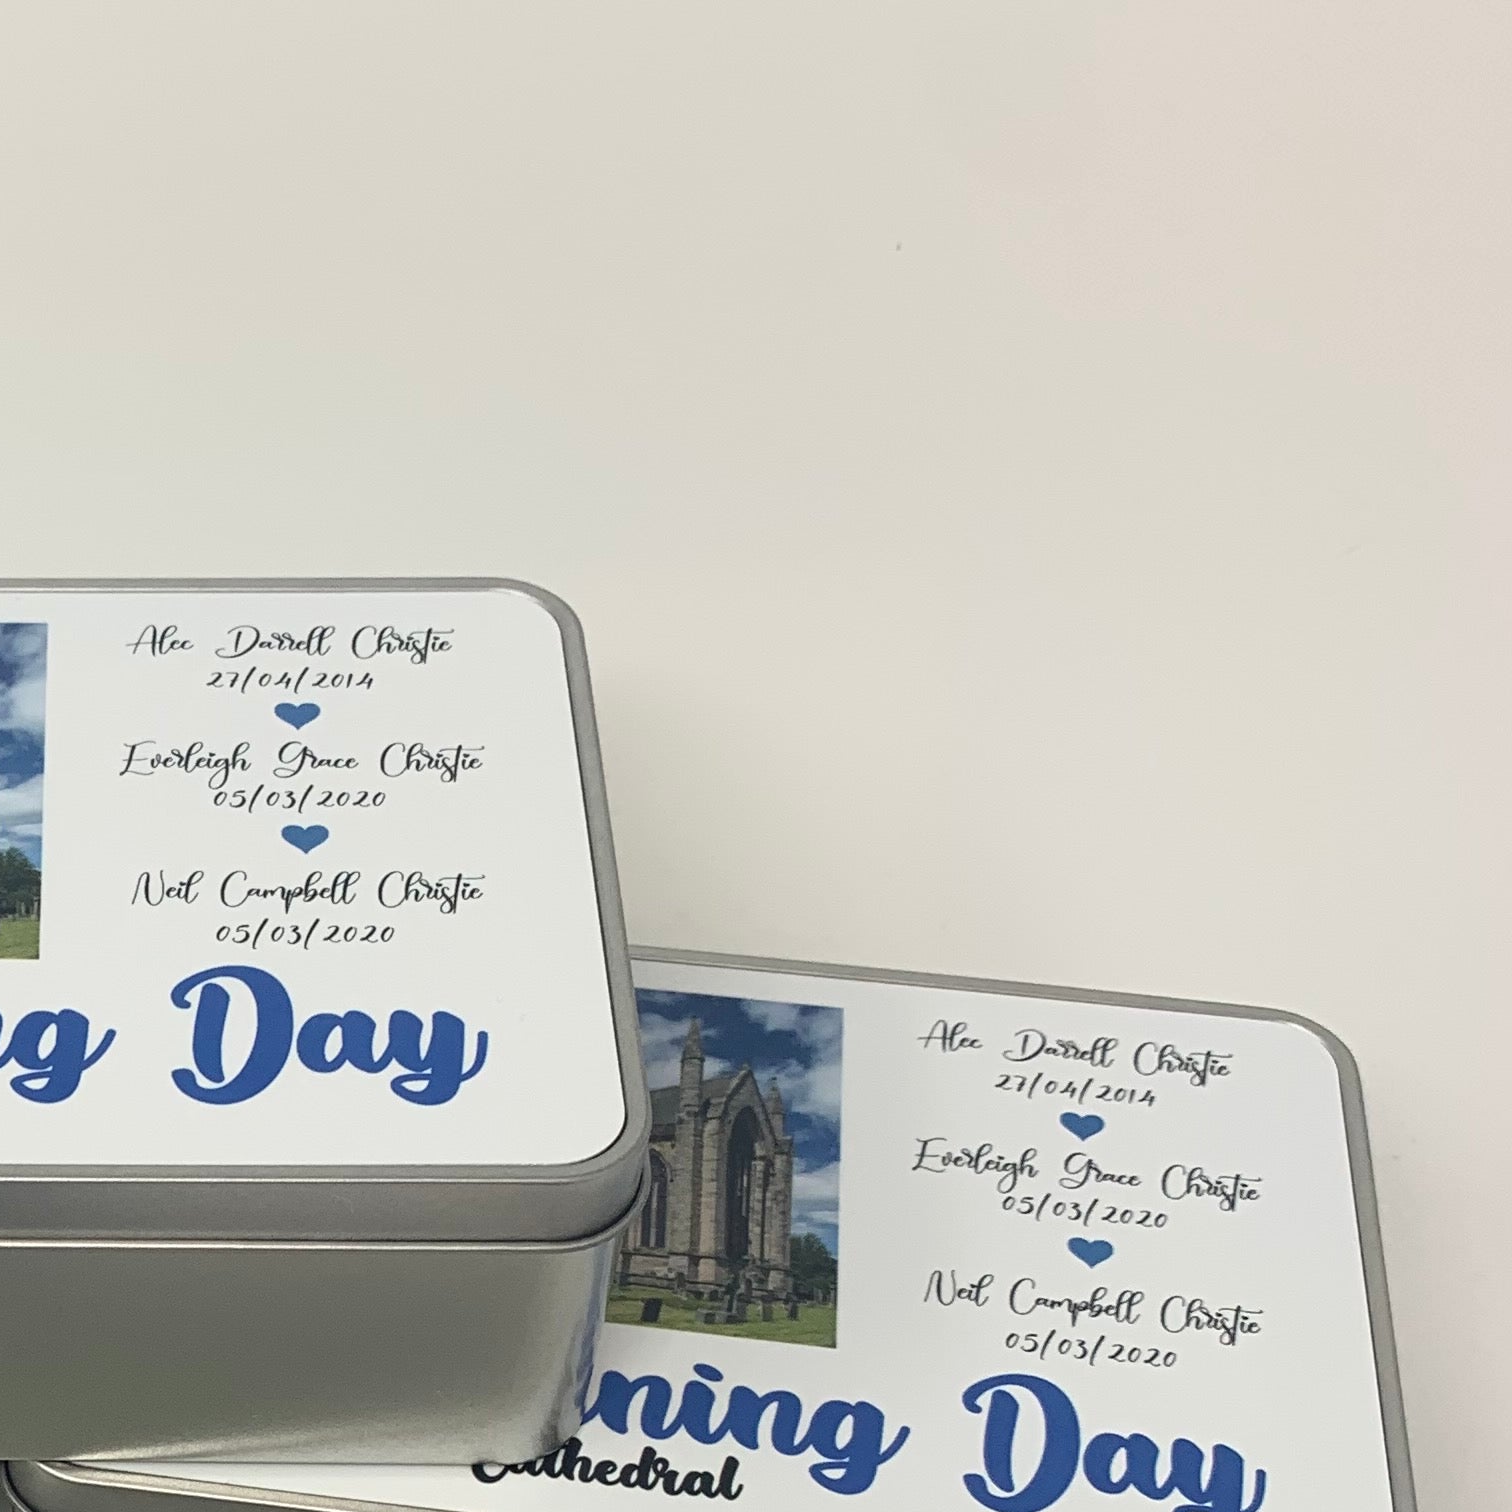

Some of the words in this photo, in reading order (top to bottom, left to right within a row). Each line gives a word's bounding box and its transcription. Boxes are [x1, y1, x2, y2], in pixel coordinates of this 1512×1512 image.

[126, 624, 194, 657] Alec
[214, 624, 336, 659] Darrell
[351, 625, 455, 665] Christie
[206, 666, 374, 694] 27/04/2014
[119, 740, 251, 790] Everleigh
[273, 741, 359, 779] Grace
[380, 742, 485, 783] Christie
[213, 784, 387, 814] 05/03/2020
[131, 869, 204, 907] Neil
[220, 870, 361, 914] Campbell
[378, 871, 486, 914] Christie
[216, 918, 395, 950] 05/03/2020
[169, 965, 488, 1107] Day
[918, 1019, 984, 1054] Alec
[1002, 1029, 1119, 1069] Darrell
[1133, 1042, 1233, 1086] Christie
[994, 1073, 1157, 1107] 27/04/2014
[912, 1137, 1039, 1193] Everleigh
[1059, 1153, 1141, 1189] Grace
[1161, 1164, 1262, 1212] Christie
[1001, 1193, 1168, 1229] 05/03/2020
[923, 1269, 994, 1307] Neil
[1008, 1277, 1145, 1327] Campbell
[1159, 1295, 1264, 1346] Christie
[1005, 1330, 1178, 1367] 05/03/2020
